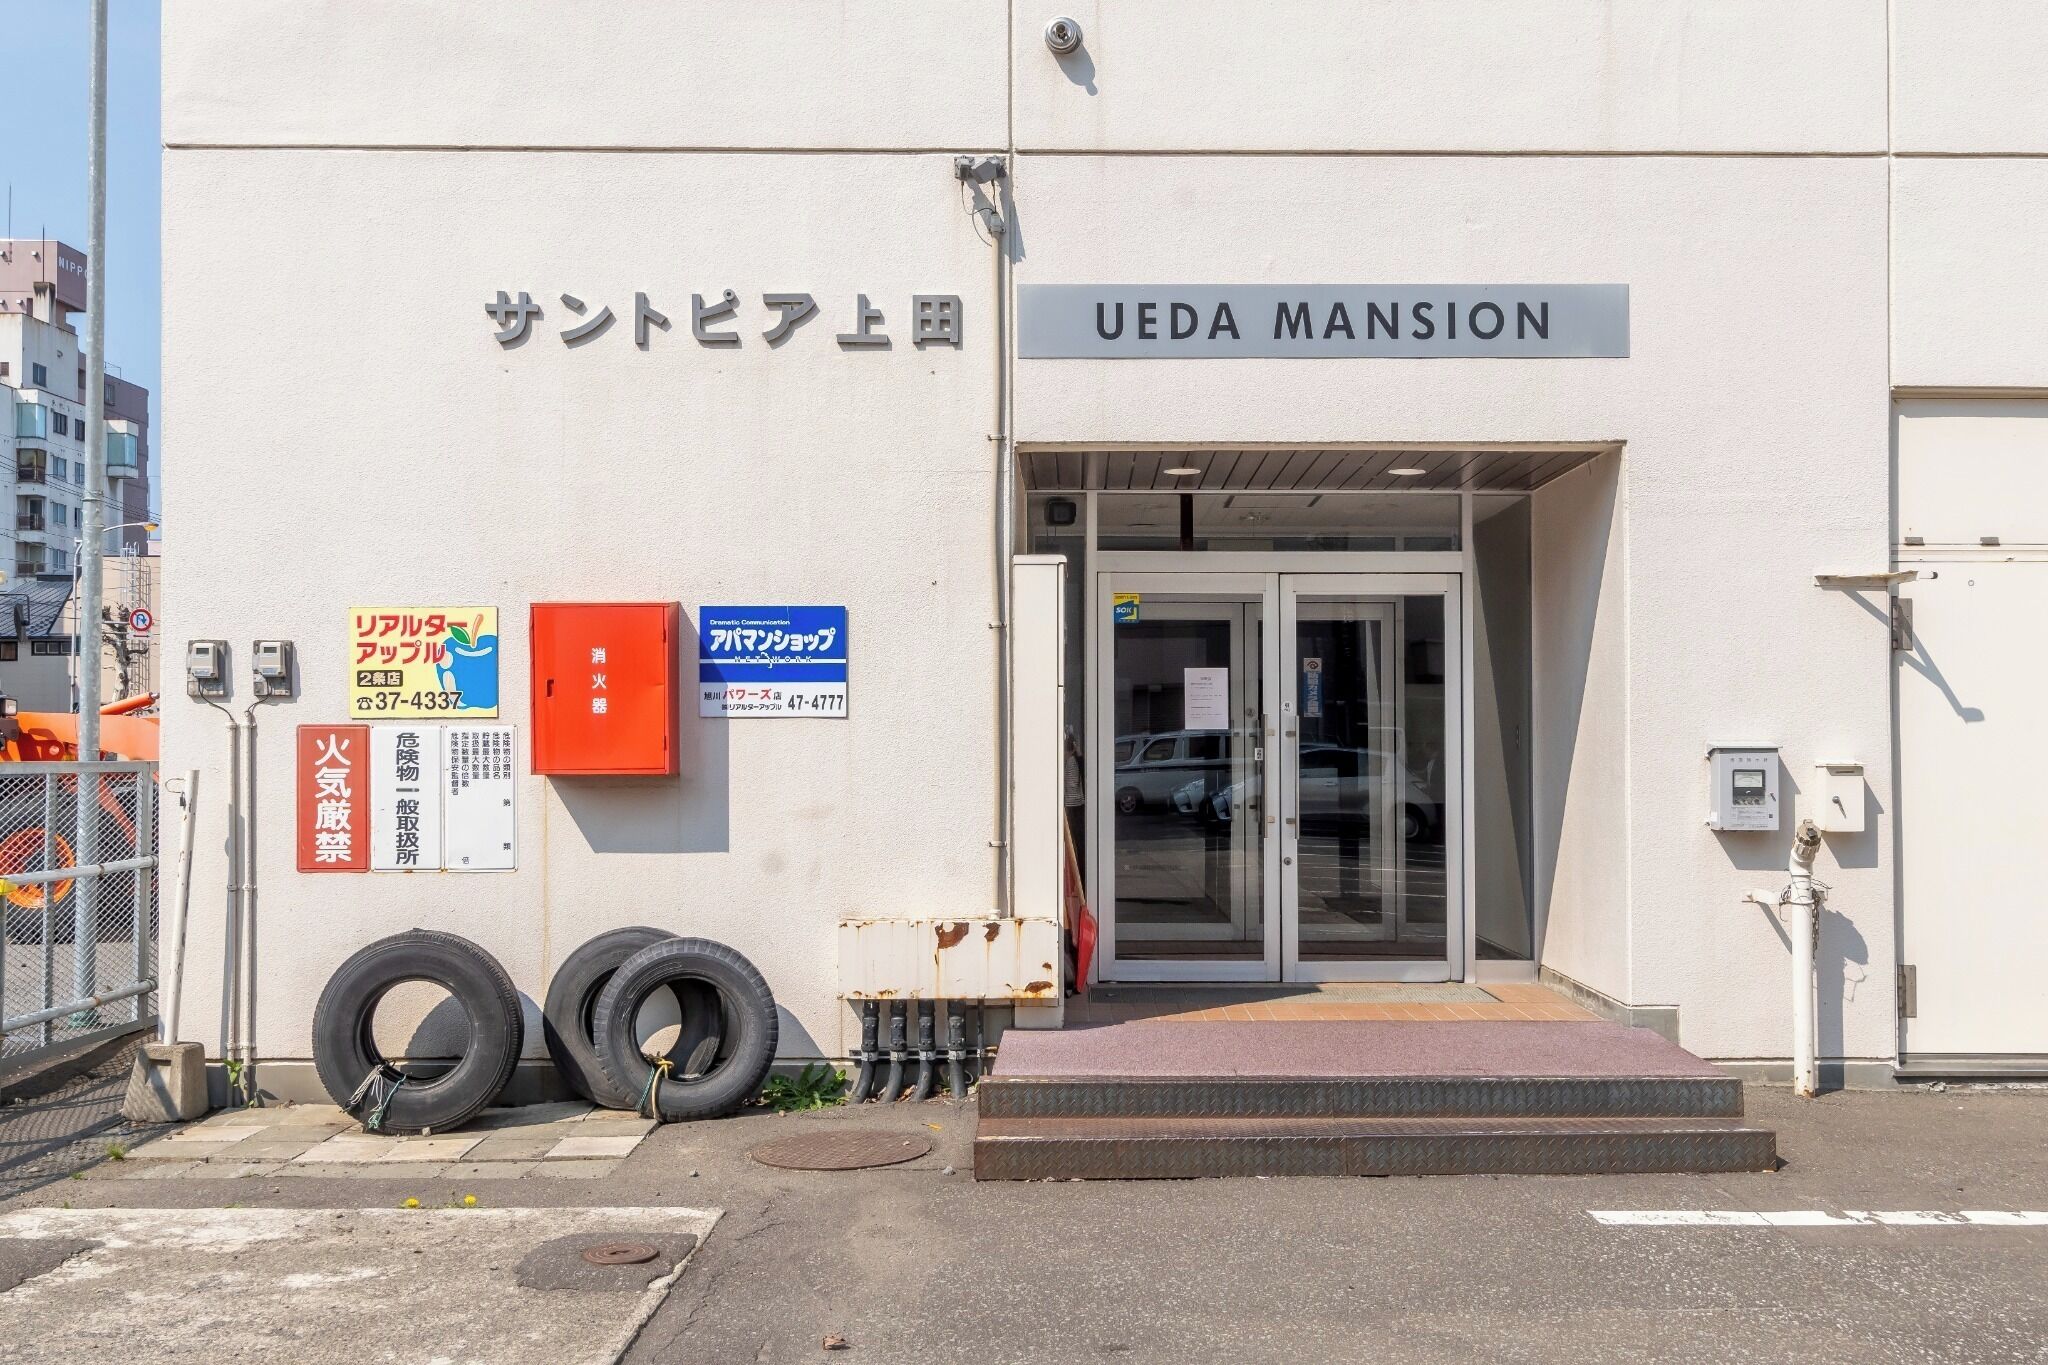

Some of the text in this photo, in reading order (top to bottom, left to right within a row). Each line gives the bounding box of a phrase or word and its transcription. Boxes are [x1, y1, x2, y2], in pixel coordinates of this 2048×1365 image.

[485, 288, 960, 347] サントピア上田
[1096, 301, 1550, 340] UEDA MANSION
[356, 614, 468, 637] リアルター
[356, 640, 446, 664] アップル
[710, 627, 837, 652] アパマンショップ
[359, 672, 401, 686] 2条店
[591, 647, 608, 714] 消火器
[375, 691, 463, 710] 37-4337
[787, 694, 844, 711] 47-4777
[314, 733, 352, 863] 火気厳禁
[395, 732, 420, 866] 危険物一般取扱所
